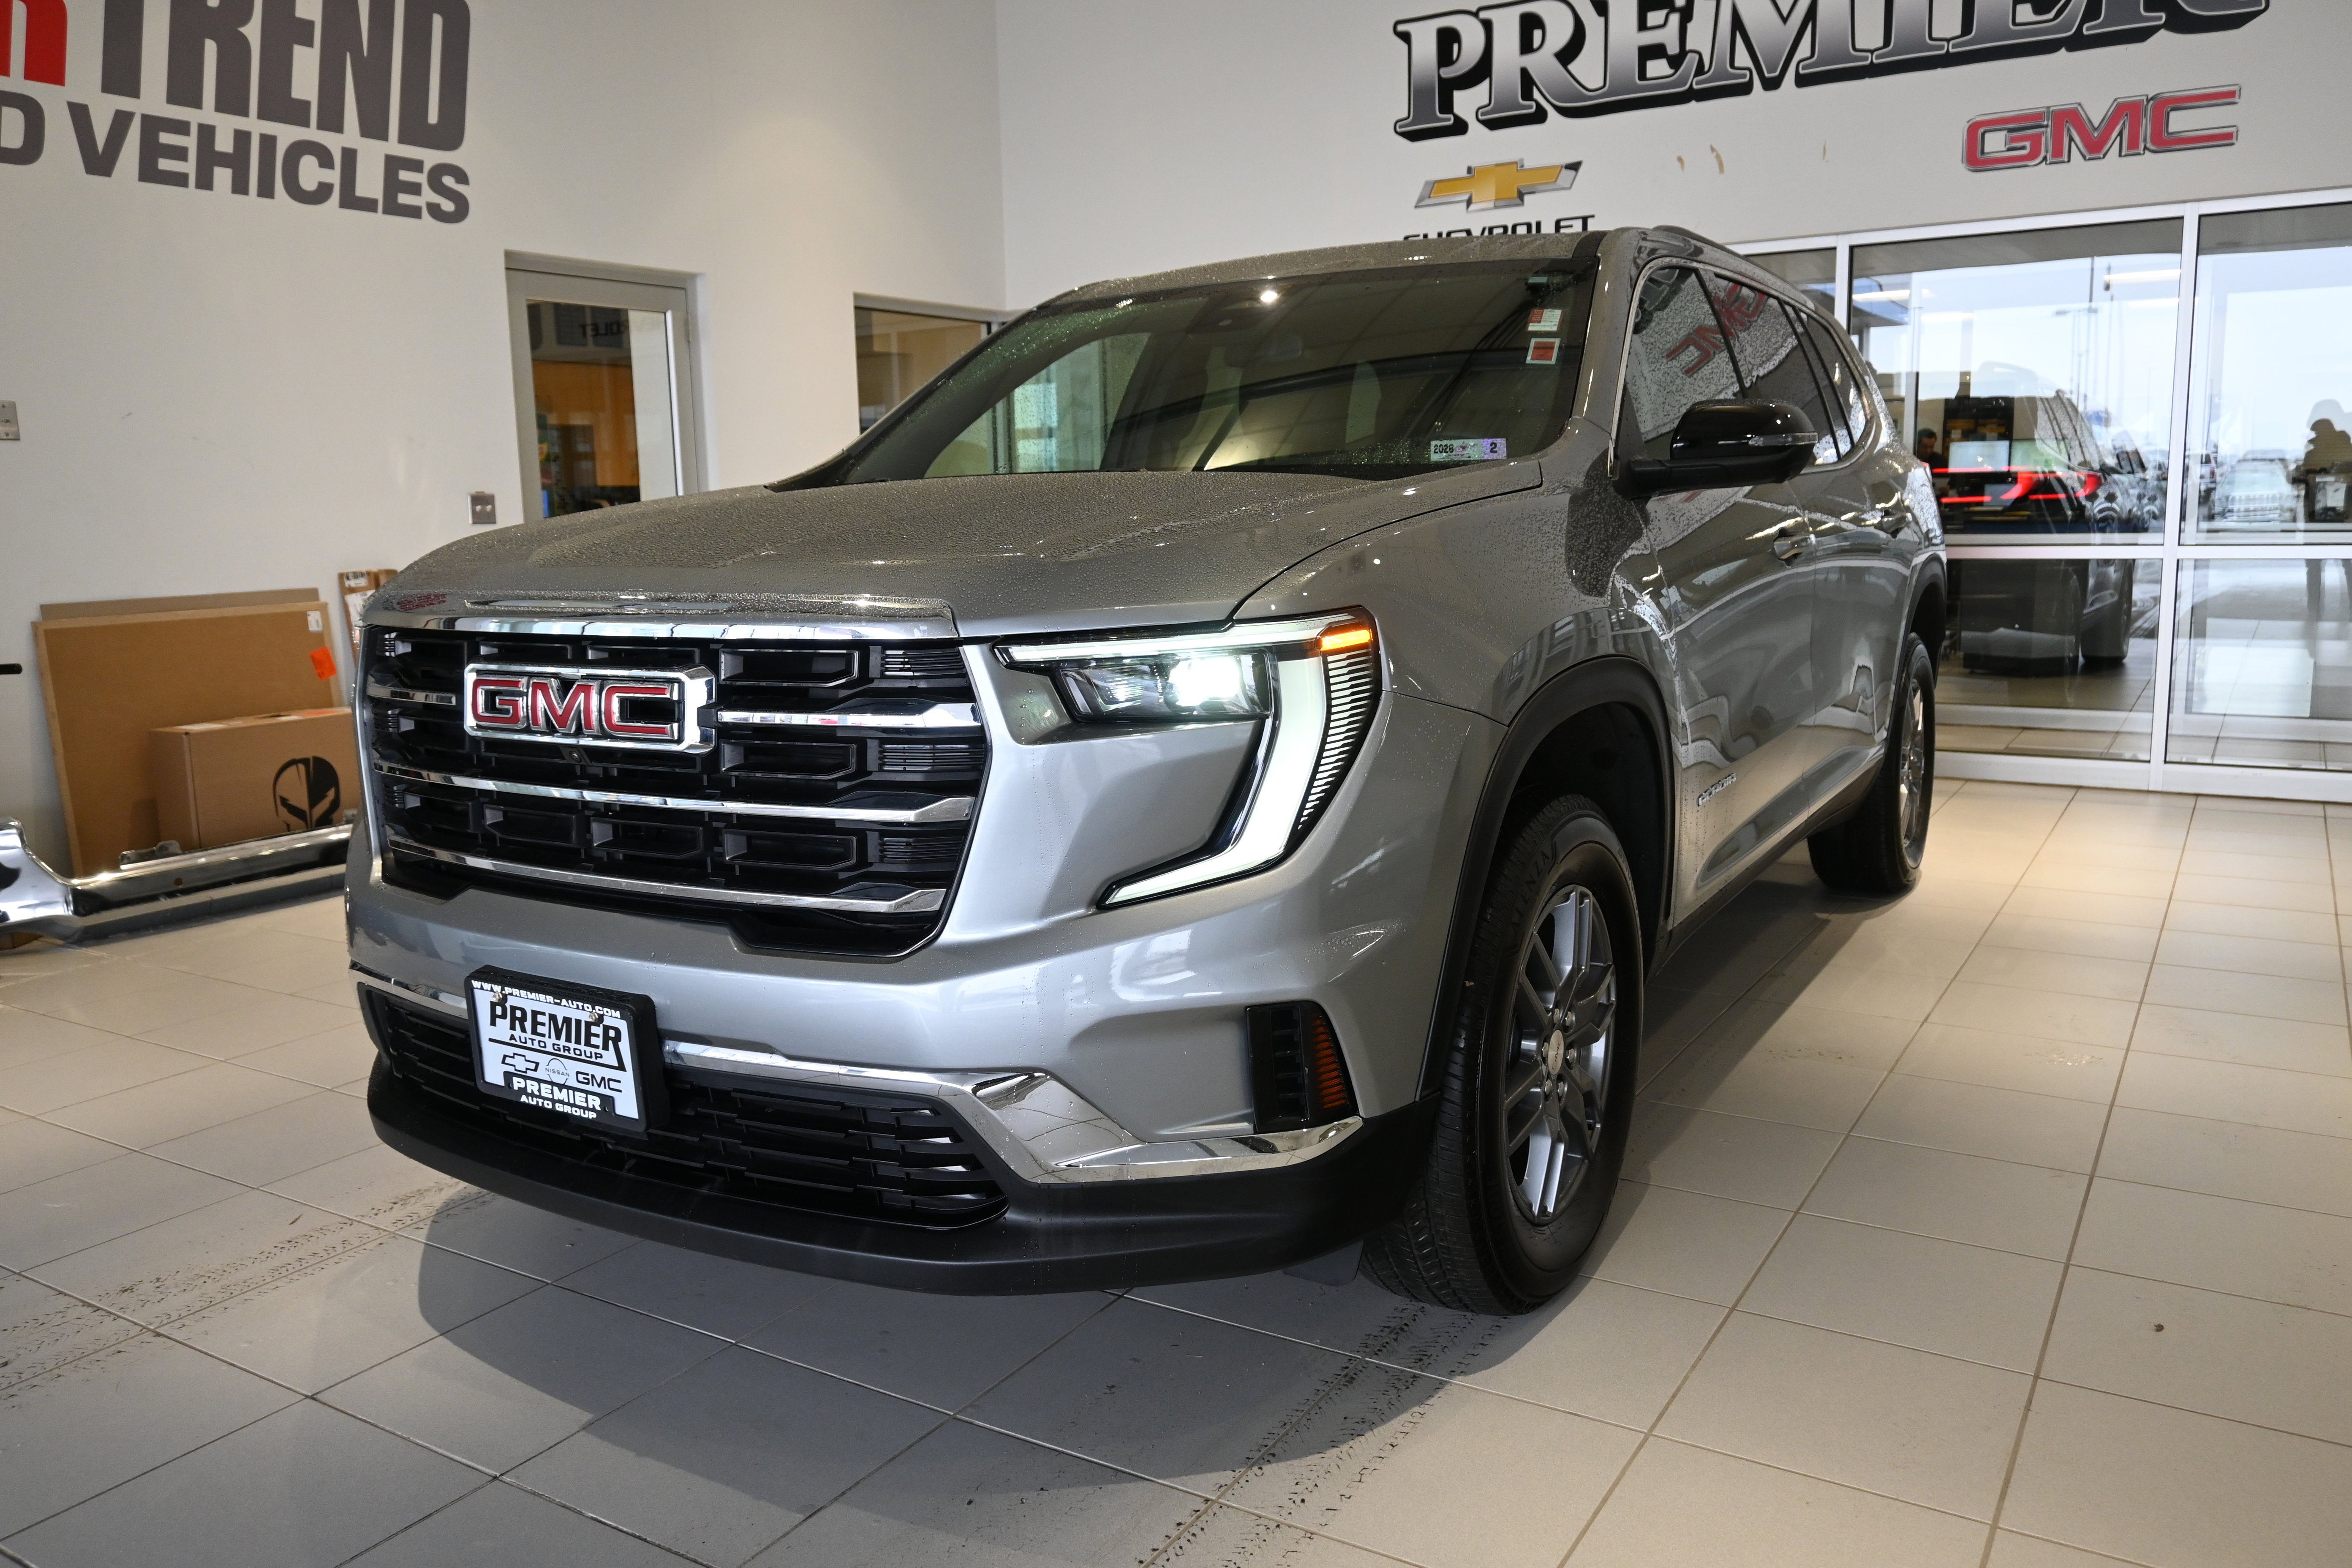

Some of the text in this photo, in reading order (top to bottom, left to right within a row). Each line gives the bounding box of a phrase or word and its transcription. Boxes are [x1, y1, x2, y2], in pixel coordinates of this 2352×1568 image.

[1394, 0, 2269, 142] PREMI
[1963, 84, 2241, 172] GMC
[66, 101, 470, 224] VEHICLES
[1403, 214, 1595, 240] VROLET
[1489, 442, 1498, 453] 2
[471, 676, 678, 740] GMC
[1696, 773, 1737, 806] ACADIA
[471, 980, 621, 1018] WWW.PREMIER-AUTO.COM
[490, 1000, 625, 1061] PREMIER
[509, 1034, 604, 1060] AUTO GROUP
[512, 1077, 601, 1111] PREMIER
[545, 1067, 622, 1093] NISSAN GMC
[520, 1095, 597, 1119] AUTO GROUP
